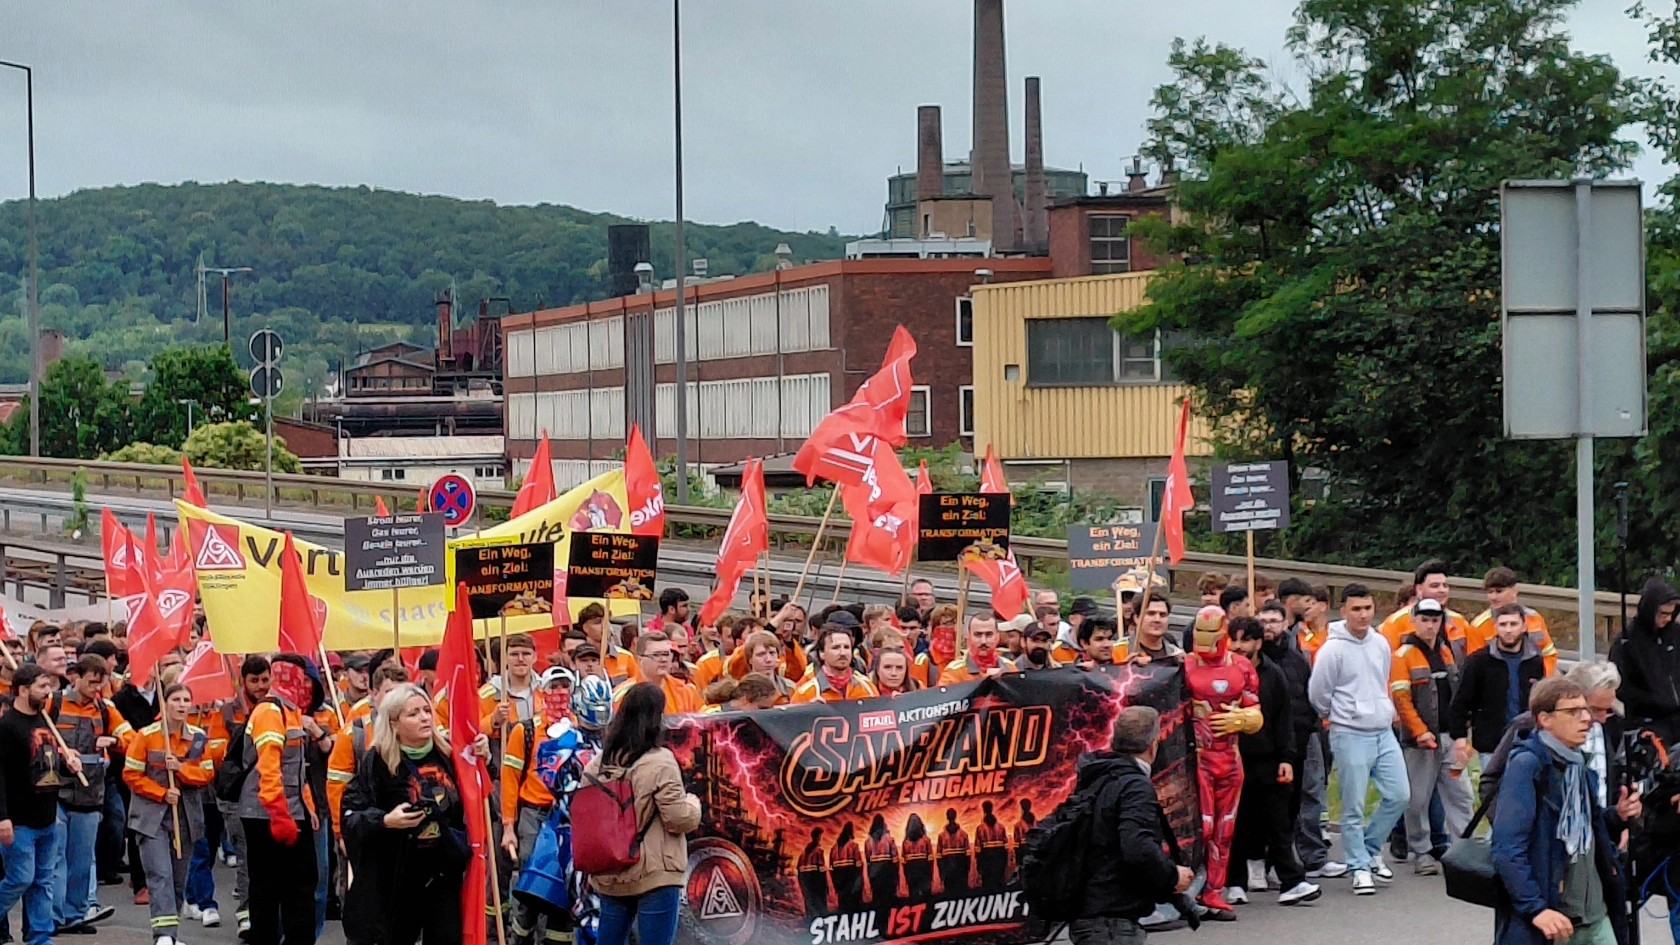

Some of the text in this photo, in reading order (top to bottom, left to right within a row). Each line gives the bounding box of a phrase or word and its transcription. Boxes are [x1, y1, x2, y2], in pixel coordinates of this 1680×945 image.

[591, 534, 609, 545] Ein
[478, 548, 498, 560] Ein
[591, 549, 609, 560] ein
[481, 564, 499, 576] ein
[569, 565, 655, 578] TRANSFORMATION
[467, 580, 552, 595] RANSFORMATION
[862, 699, 970, 728] STAHL AKTIONSTAG
[800, 706, 1052, 796] SAARLAND
[854, 771, 1007, 813] THE ENDGAME
[809, 910, 879, 944] STAHL
[886, 903, 926, 935] IST
